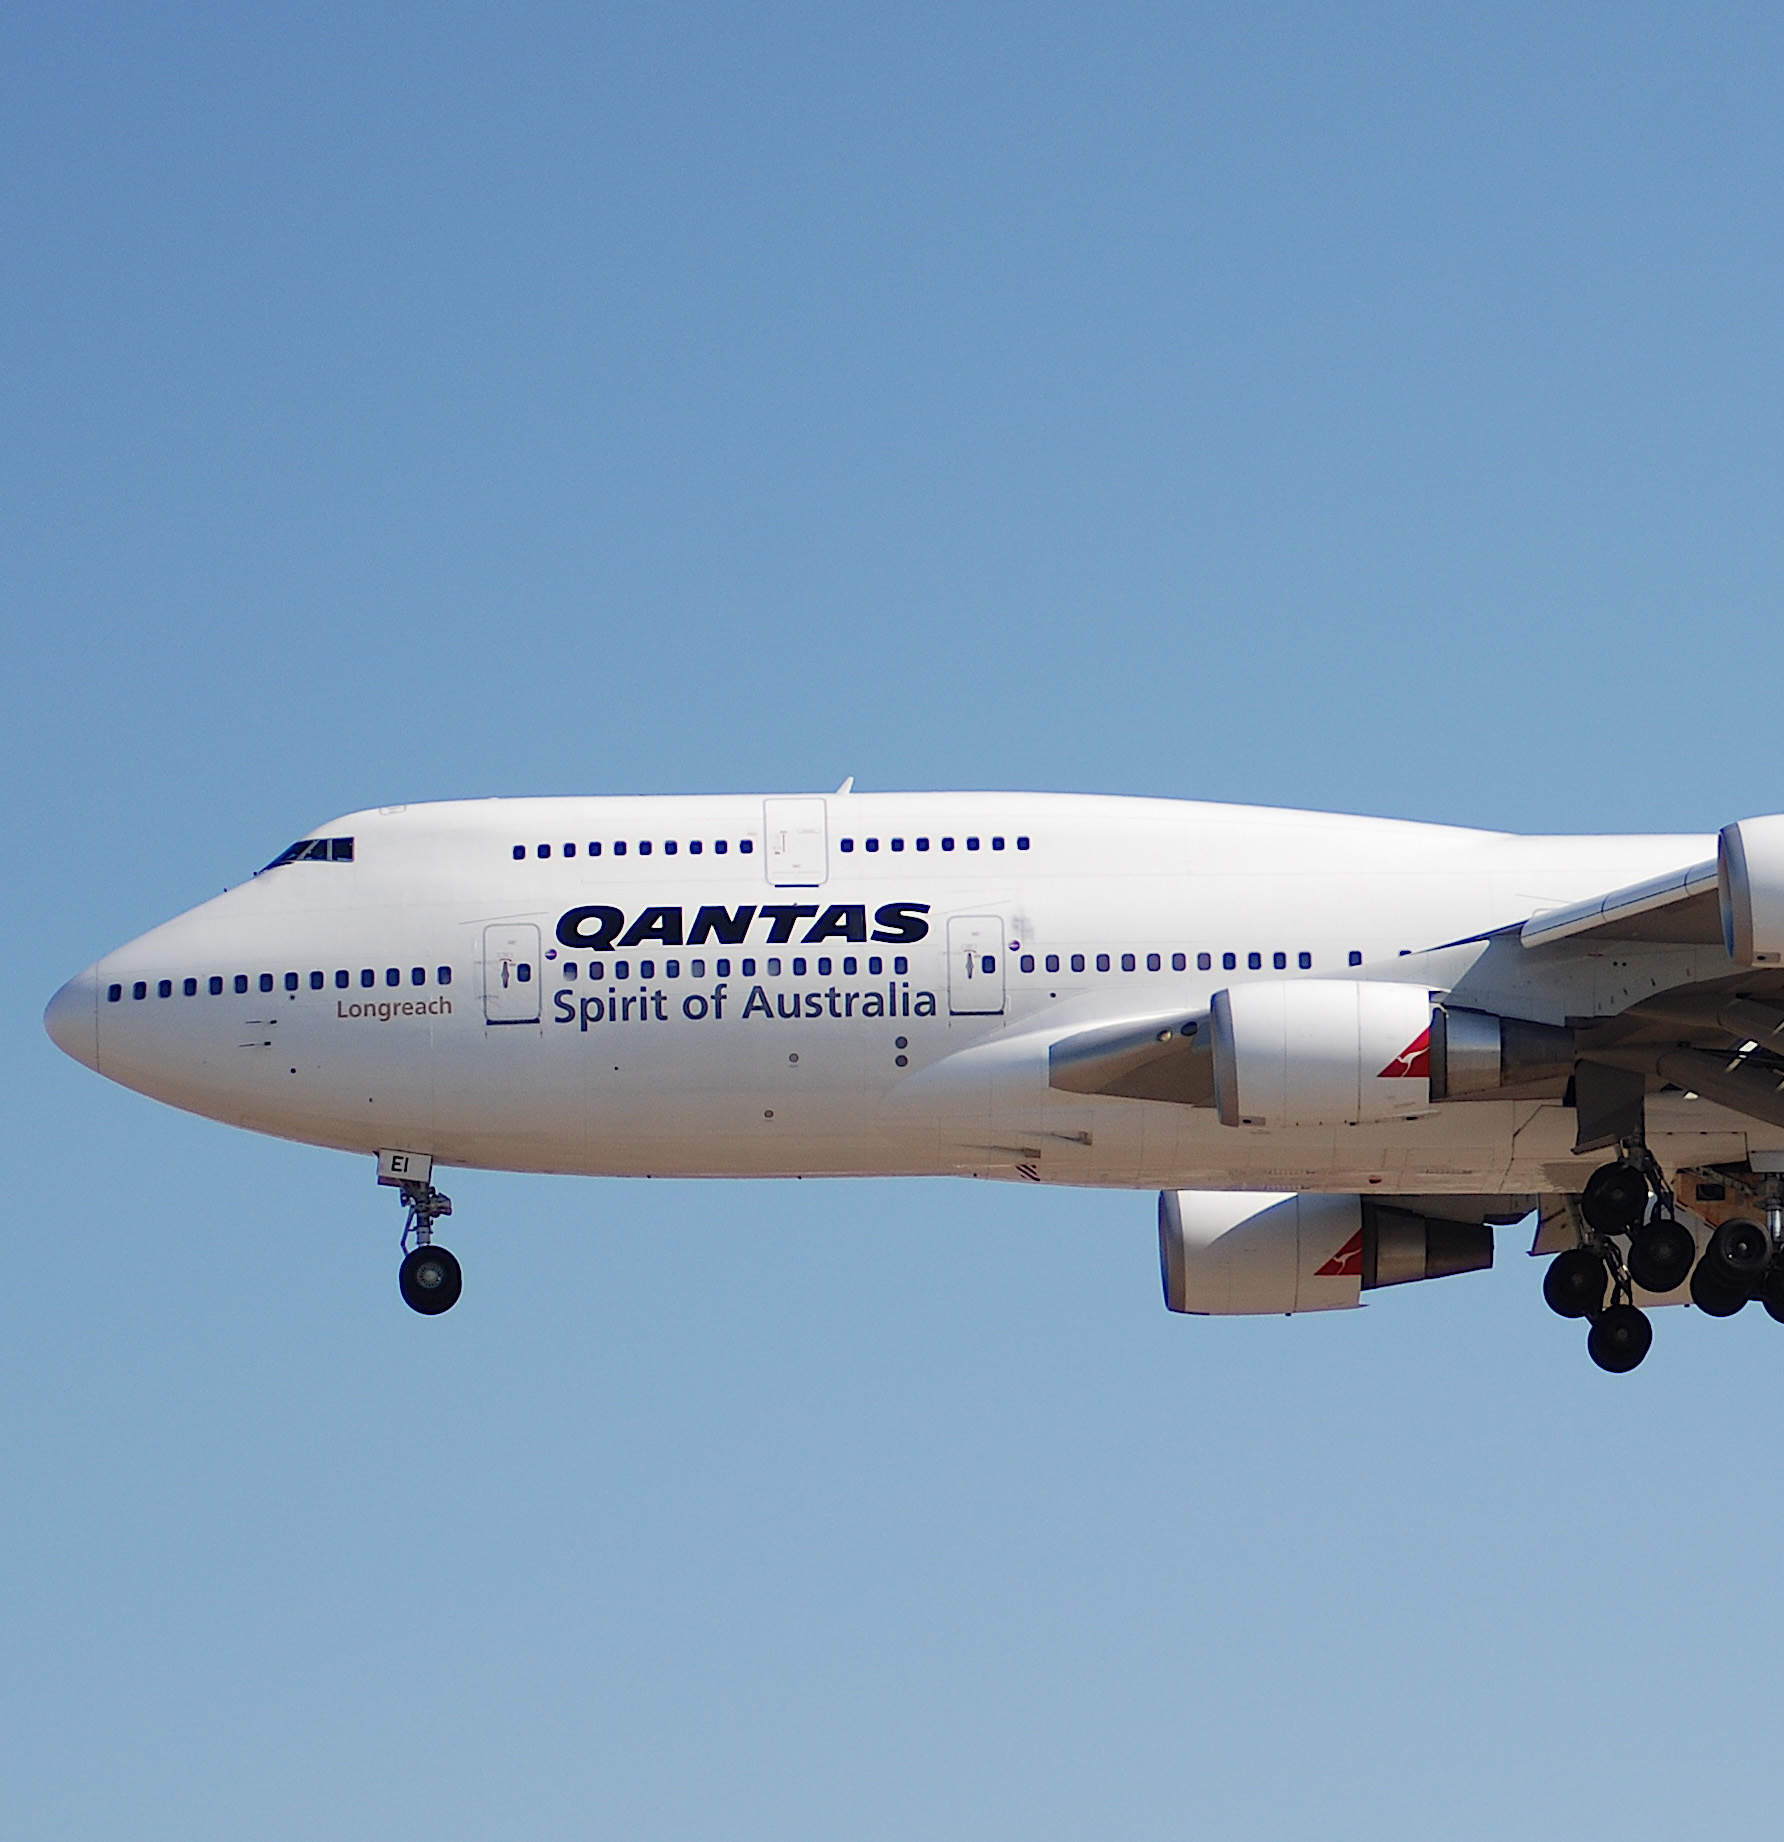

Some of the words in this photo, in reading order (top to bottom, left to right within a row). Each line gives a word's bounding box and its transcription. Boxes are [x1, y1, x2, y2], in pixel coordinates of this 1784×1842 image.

[555, 902, 931, 951] QANTAS
[337, 995, 452, 1022] Longreach
[554, 986, 667, 1031] Spirit
[682, 983, 727, 1020] of
[742, 981, 936, 1019] Australia
[391, 1155, 409, 1172] EI
